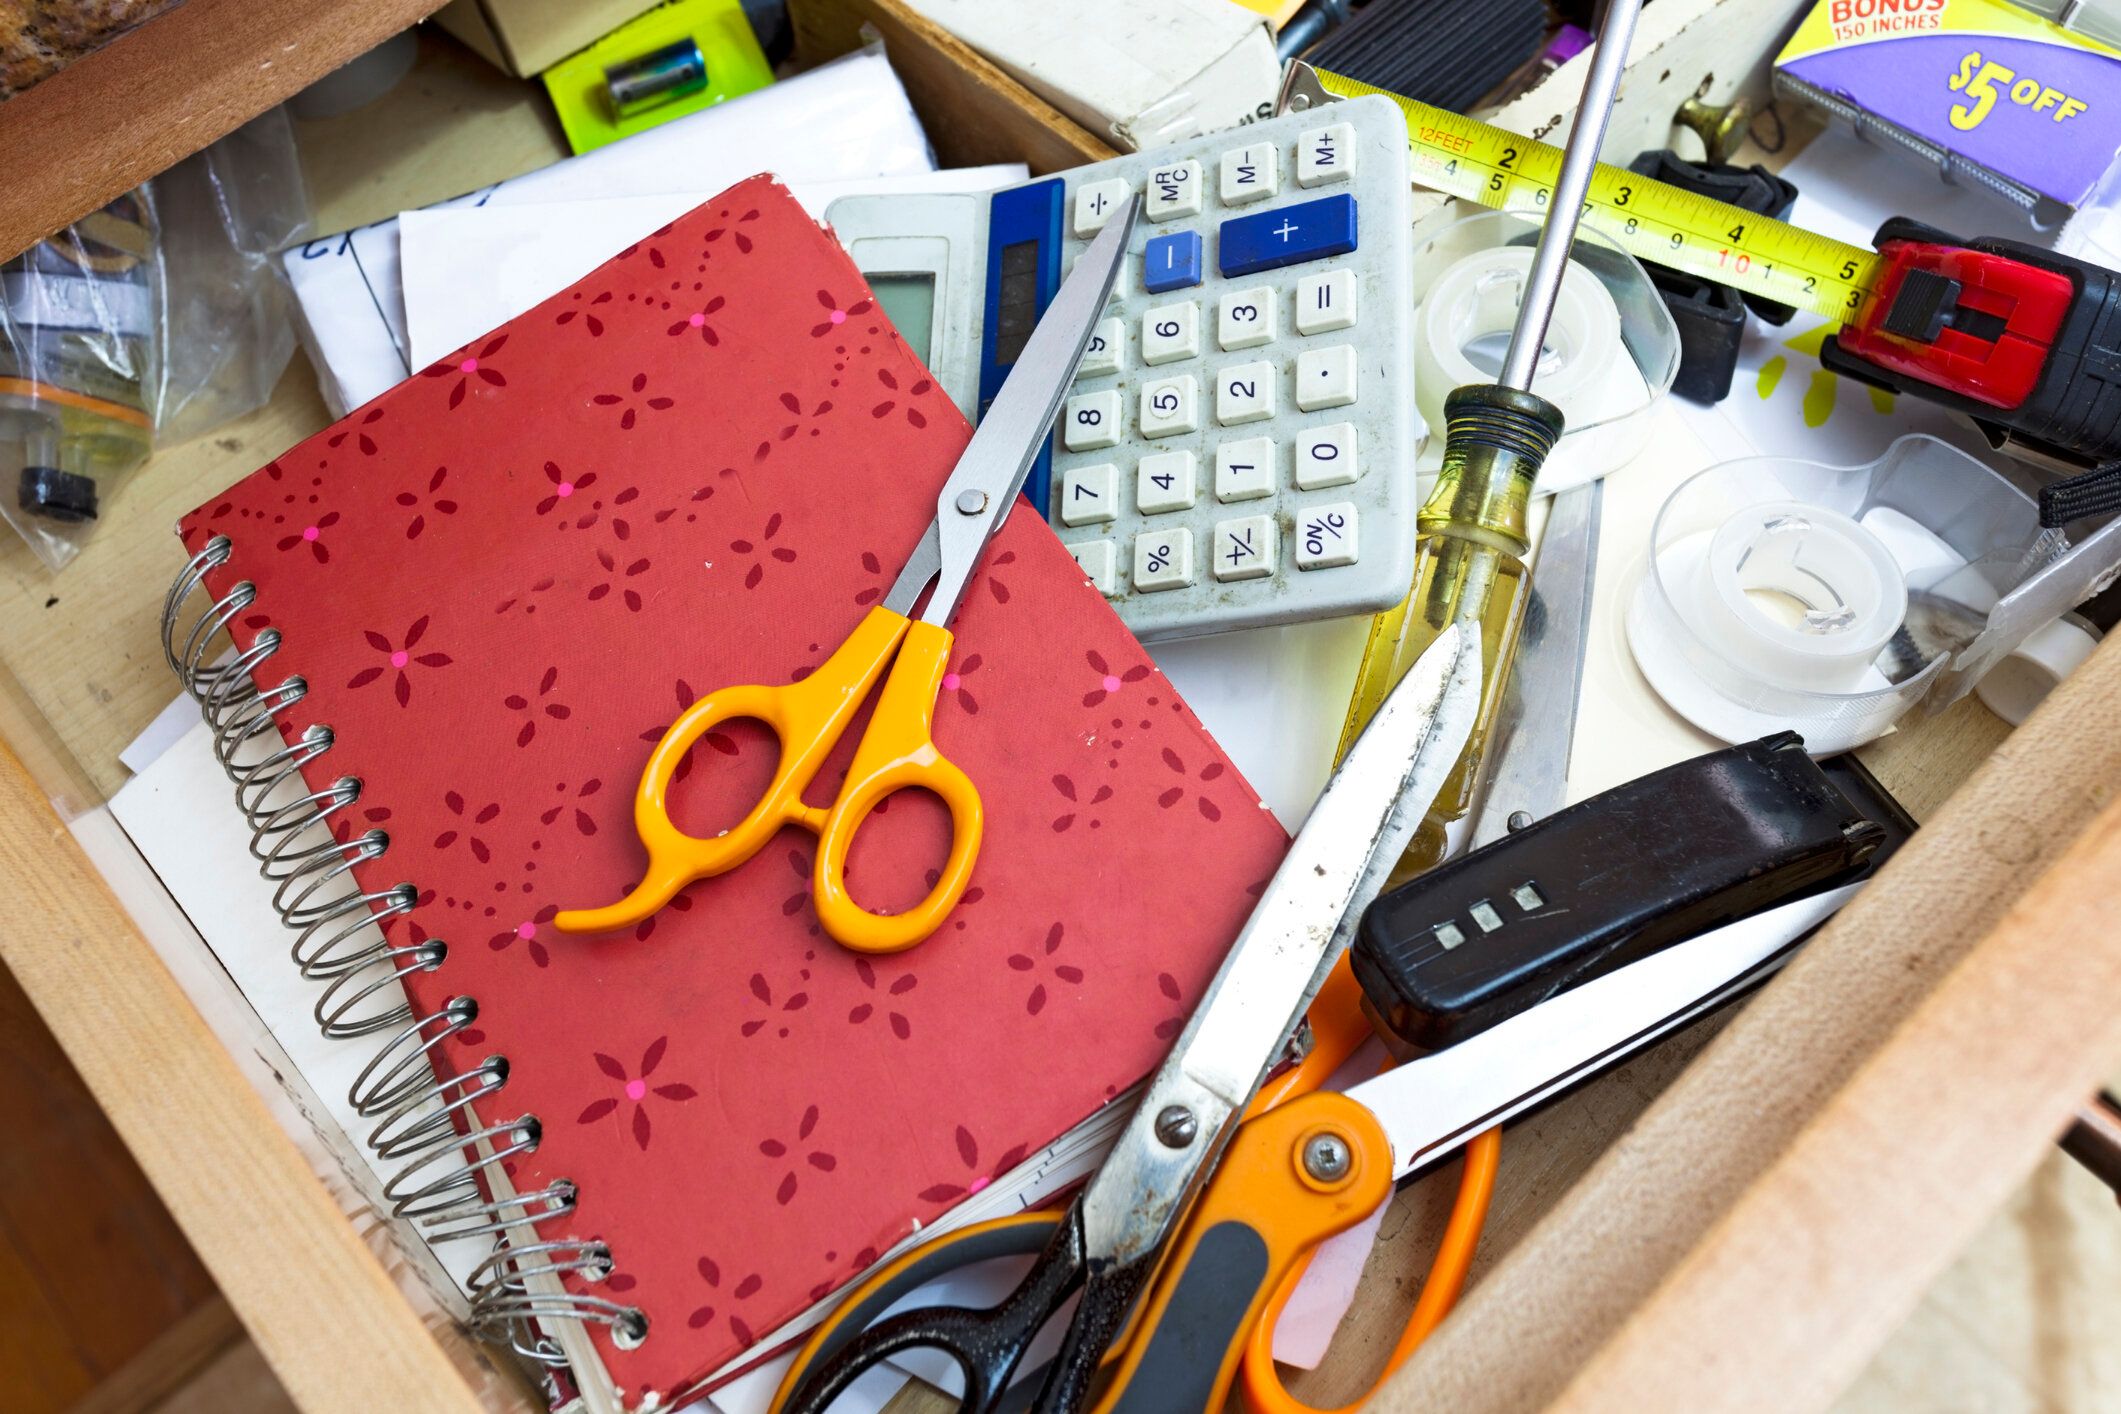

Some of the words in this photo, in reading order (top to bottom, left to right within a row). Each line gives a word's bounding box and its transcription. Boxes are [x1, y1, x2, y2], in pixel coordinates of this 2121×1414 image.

[1832, 0, 1945, 23] BONUS
[1835, 22, 1865, 40] 150
[1873, 14, 1940, 33] INCHES
[2009, 78, 2089, 122] OFF
[1498, 148, 1517, 169] 2
[1614, 186, 1632, 206] 3
[1728, 224, 1745, 243] 4
[1839, 261, 1859, 280] 5
[1444, 159, 1458, 176] 4
[1489, 173, 1505, 191] 5
[1535, 188, 1549, 206] 6
[1624, 218, 1638, 235] 8
[1670, 232, 1683, 250] 9
[1802, 276, 1817, 294] 2
[1846, 290, 1861, 308] 3
[1232, 304, 1258, 322] 3
[1156, 321, 1180, 338] 6
[1230, 381, 1256, 398] 2
[1154, 394, 1179, 411] 5
[1078, 409, 1102, 426] 8
[1230, 462, 1255, 475] 1
[1151, 473, 1176, 491] 4
[1075, 484, 1099, 501] 7
